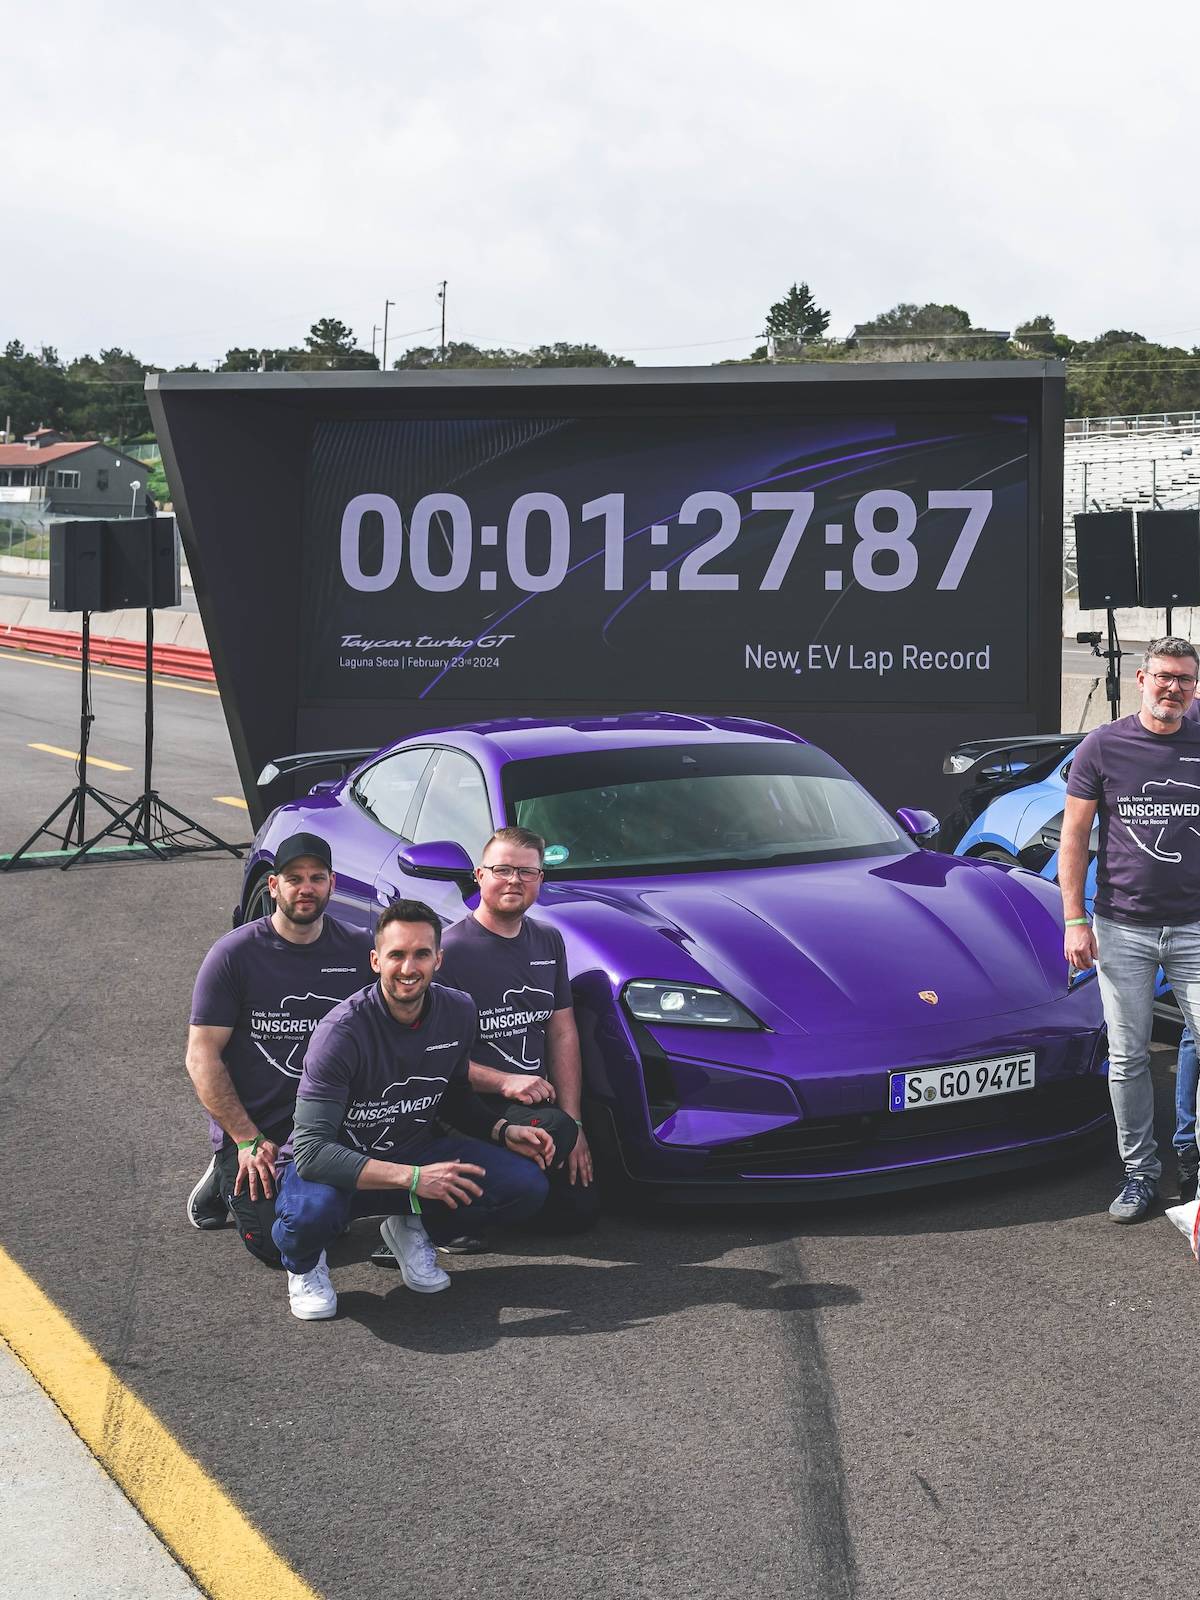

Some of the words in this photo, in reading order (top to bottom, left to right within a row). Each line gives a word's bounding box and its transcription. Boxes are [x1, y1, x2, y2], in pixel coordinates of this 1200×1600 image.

[339, 489, 994, 592] 00:01:27:87
[341, 635, 412, 652] Taycan
[415, 635, 474, 648] turbo
[477, 635, 516, 648] GT
[339, 656, 374, 669] Laguna
[376, 656, 399, 668] Seca
[408, 656, 450, 670] February
[473, 656, 500, 668] 2024
[745, 644, 800, 669] New
[808, 644, 841, 669] EV
[850, 644, 894, 676] Lap
[903, 644, 990, 670] Record
[1118, 803, 1200, 817] UNSCREWED
[1139, 818, 1149, 826] Lap
[251, 1010, 267, 1018] Look,
[480, 1010, 550, 1031] UNSCREWED
[494, 1031, 502, 1039] EV
[895, 1096, 901, 1105] D
[907, 1076, 923, 1104] S
[940, 1070, 970, 1099] GO
[975, 1059, 1032, 1094] 947E
[347, 1096, 432, 1121] UNSCREWED
